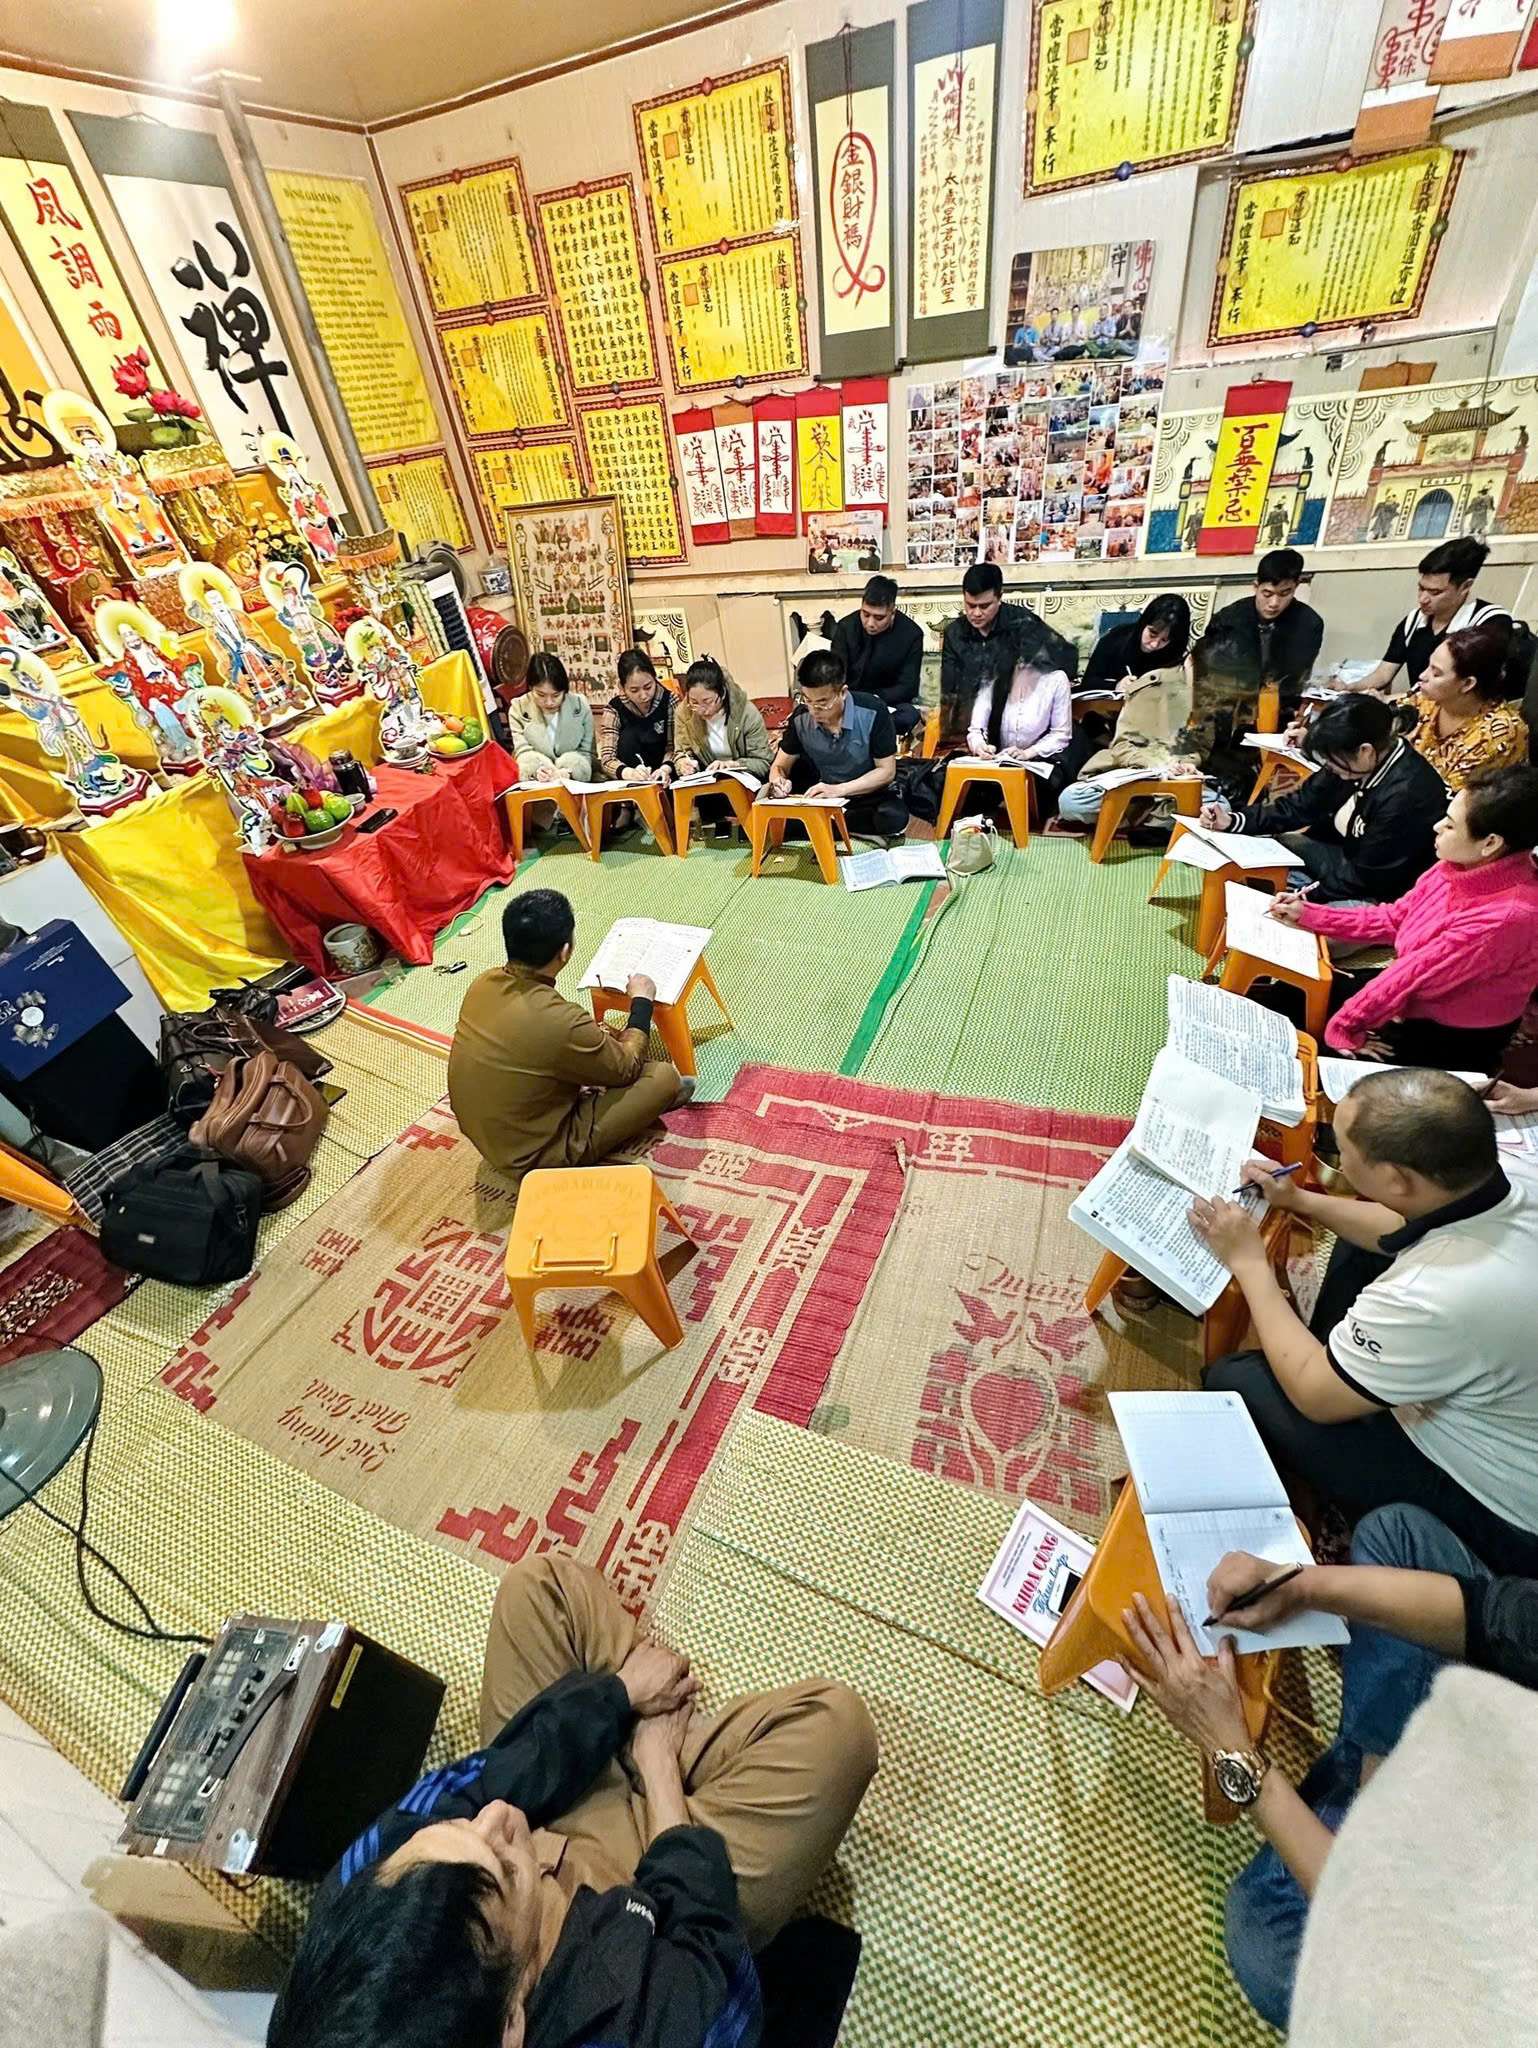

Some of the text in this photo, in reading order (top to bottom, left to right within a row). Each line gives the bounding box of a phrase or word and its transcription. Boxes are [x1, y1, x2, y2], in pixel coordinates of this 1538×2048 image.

[1217, 422, 1270, 523] 百無禁忌
[1012, 1570, 1042, 1615] KHOA
